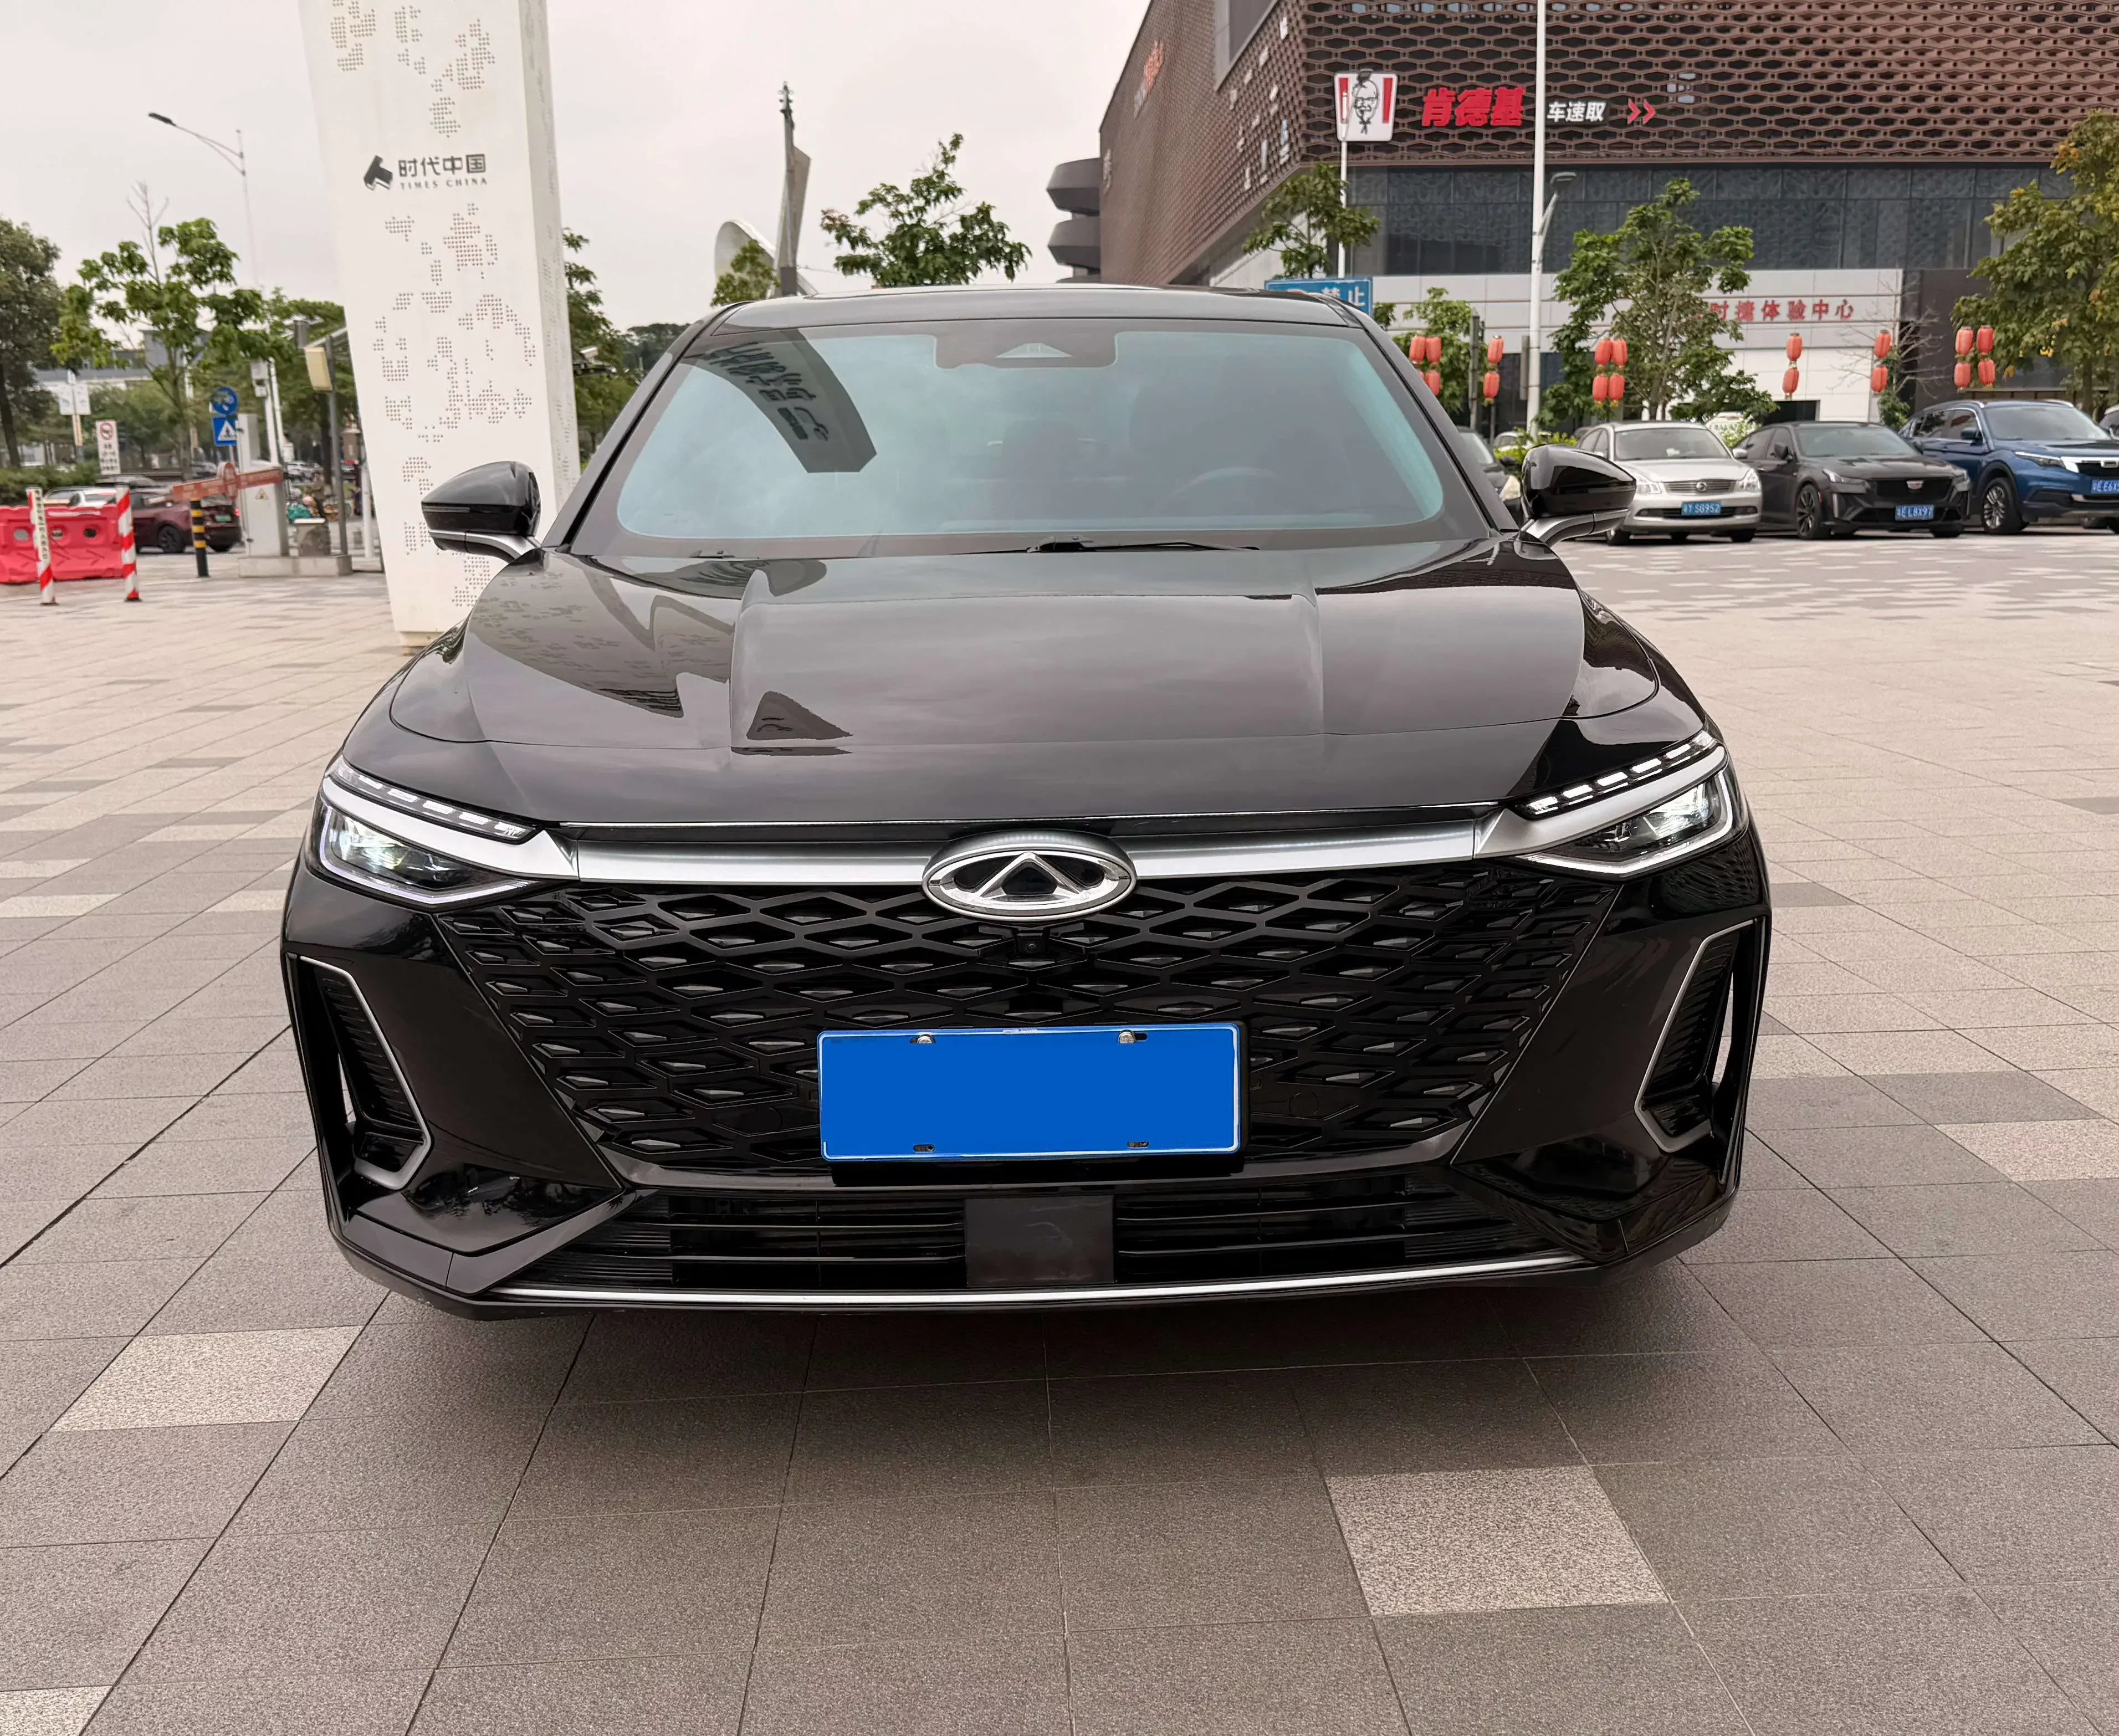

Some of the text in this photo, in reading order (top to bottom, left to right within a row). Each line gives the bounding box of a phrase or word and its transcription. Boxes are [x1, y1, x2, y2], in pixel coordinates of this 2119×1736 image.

[1422, 86, 1607, 127] 肯德基 车速取
[398, 153, 486, 177] 时代中国
[400, 177, 488, 190] TIMES CHINA
